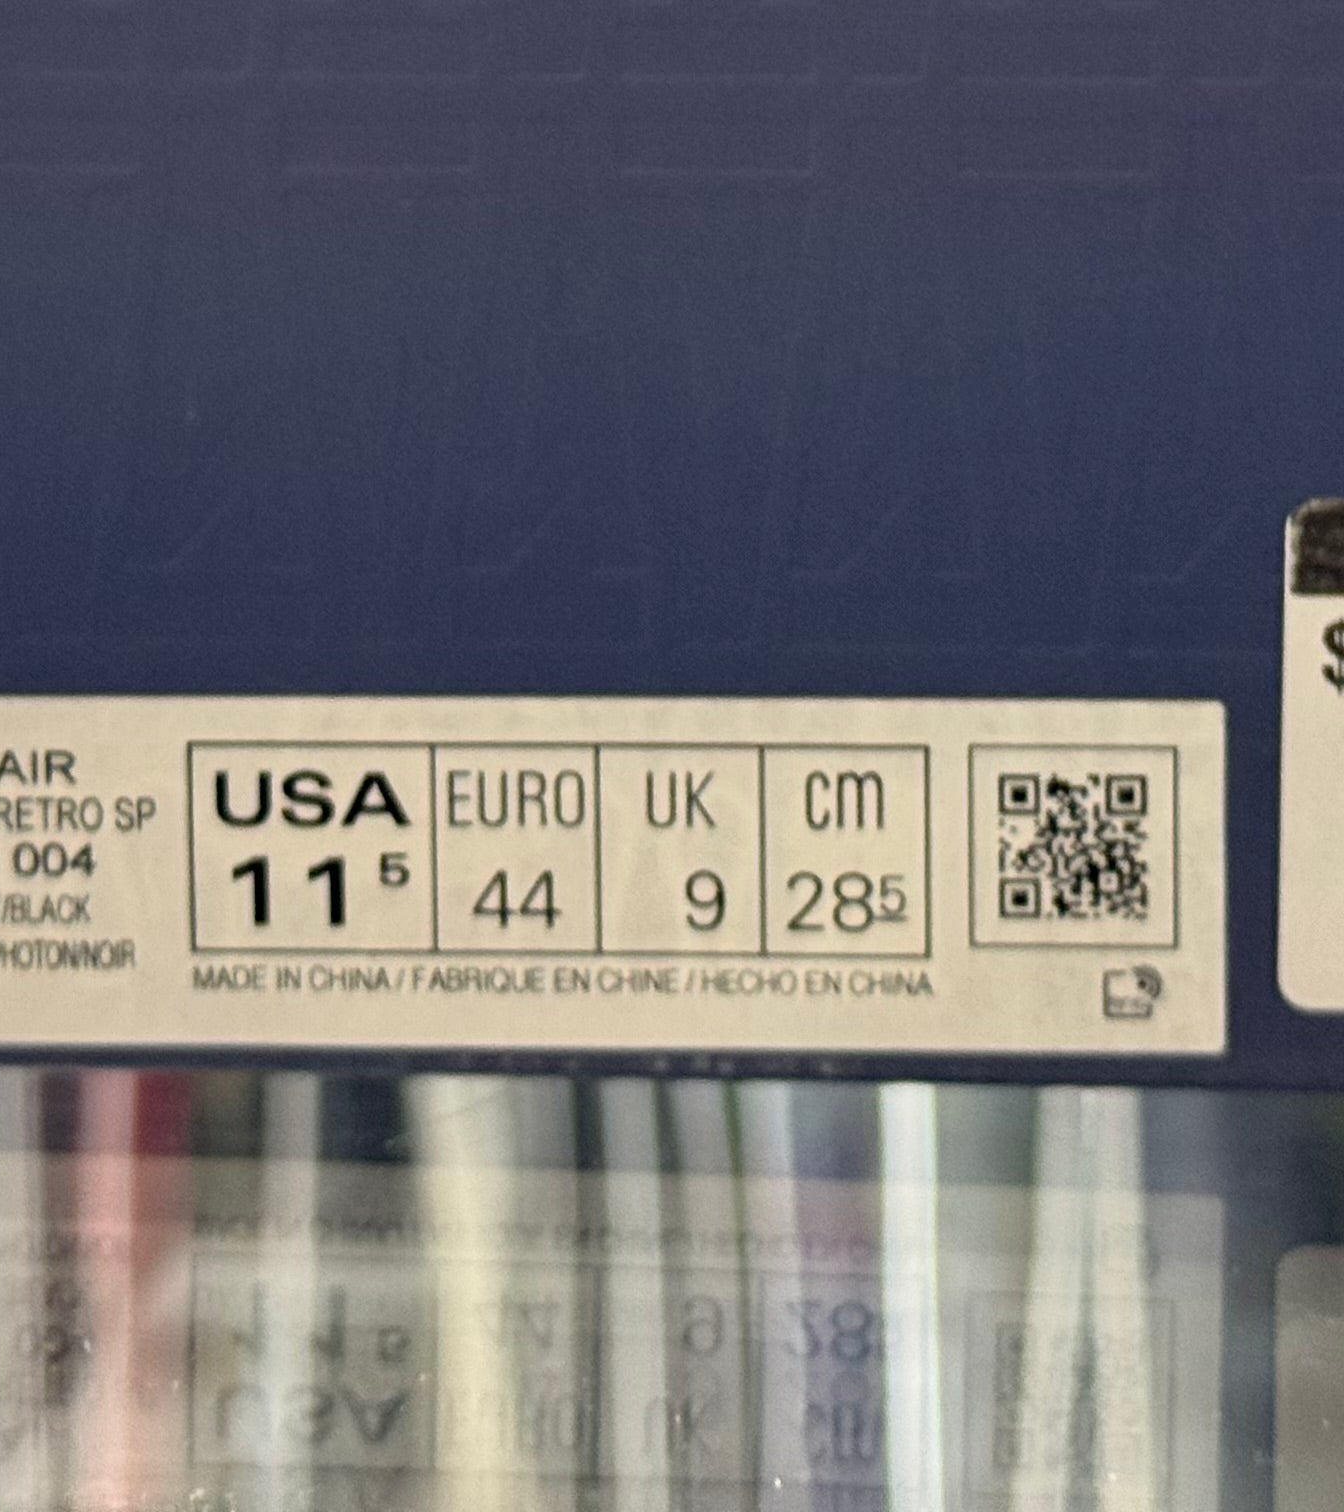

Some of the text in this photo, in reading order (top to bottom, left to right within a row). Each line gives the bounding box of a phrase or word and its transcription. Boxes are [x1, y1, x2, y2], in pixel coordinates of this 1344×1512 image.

[114, 796, 157, 832] SP
[214, 769, 411, 828] USA
[446, 769, 586, 828] EURO
[645, 769, 716, 829] UK
[13, 841, 96, 877] 004
[473, 868, 562, 929] 44
[685, 868, 727, 932] 9
[192, 964, 265, 991] MADE
[276, 964, 301, 991] IN
[307, 964, 390, 992] CHINA
[412, 965, 547, 994] FABRIQUE
[555, 966, 590, 993] EN
[597, 967, 680, 994] CHINE
[703, 967, 799, 995] HECHO
[805, 968, 843, 995] EN
[848, 968, 935, 996] CHINA
